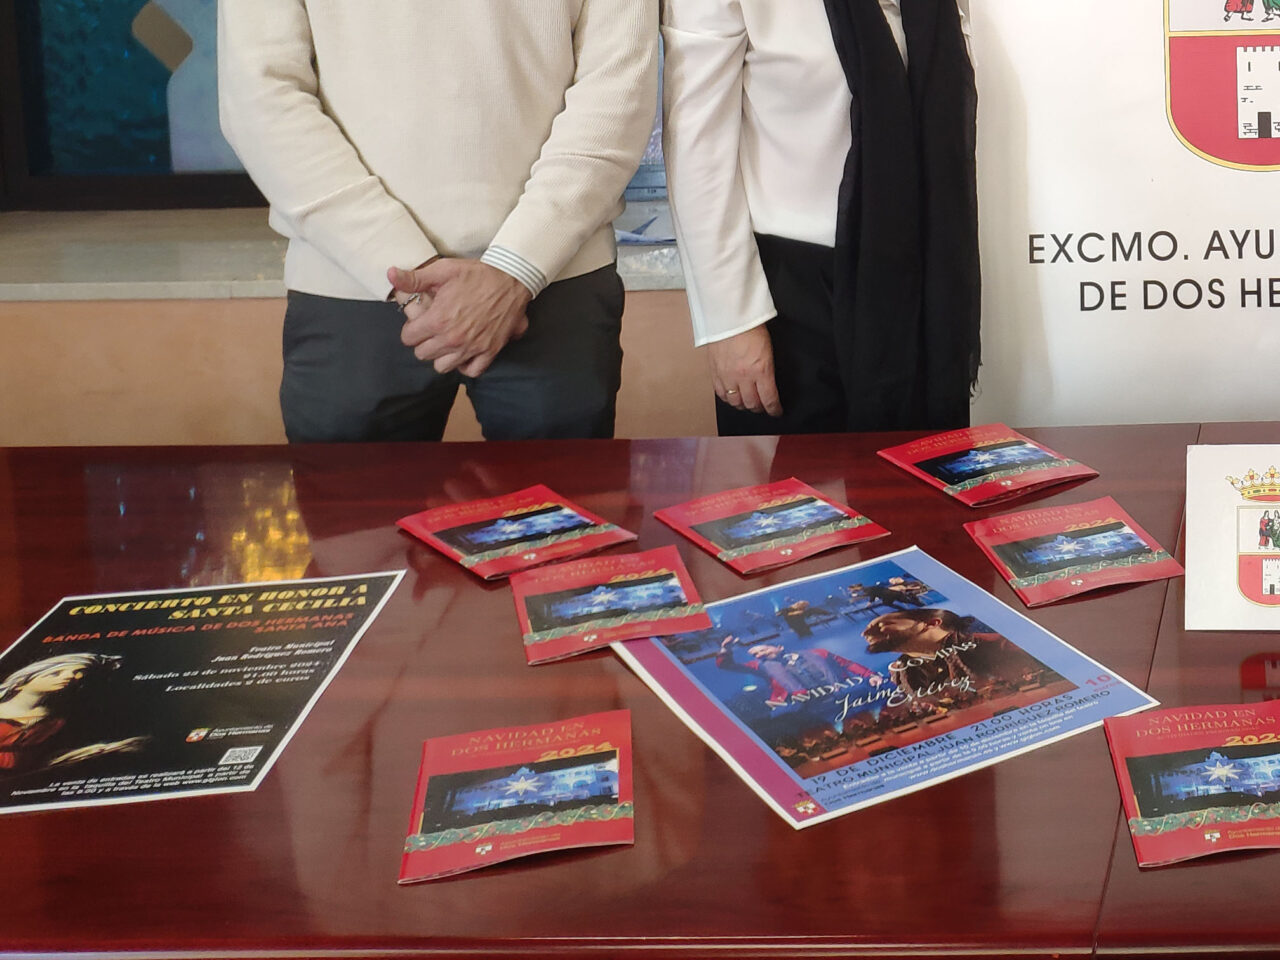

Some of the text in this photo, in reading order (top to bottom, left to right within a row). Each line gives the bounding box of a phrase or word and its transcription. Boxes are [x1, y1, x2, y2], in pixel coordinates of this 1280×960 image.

[1028, 231, 1189, 264] EXCMO.
[1079, 280, 1127, 312] DE
[1143, 278, 1226, 310] DOS
[67, 584, 371, 615] CONCIERTO EN HONOR A
[167, 596, 370, 620] SANTA CECILIA
[43, 633, 102, 642] BANDA
[132, 624, 198, 635] MÚSICA
[226, 620, 259, 628] DOS
[265, 613, 355, 624] HERMANAS
[253, 624, 307, 632] SANTA
[765, 675, 863, 711] NAVIDAD
[1083, 674, 1113, 686] 10
[834, 685, 906, 722] Jaime
[1150, 709, 1256, 725] NAVIDAD EN
[469, 722, 584, 744] NAVIDAD EN
[835, 765, 860, 776] DE
[865, 733, 957, 766] DICIEMBRE
[1017, 694, 1074, 715] HORAS
[856, 749, 935, 778] MUNICIPAL
[933, 736, 973, 751] JUAN
[974, 709, 1054, 738] RODRÍGUEZ
[1053, 690, 1112, 711] ROMERO
[1136, 725, 1171, 738] DOS
[1177, 716, 1276, 732] HERMANAS
[452, 745, 489, 757] DOS
[496, 728, 601, 750] HERMANAS
[538, 741, 613, 759] 2024
